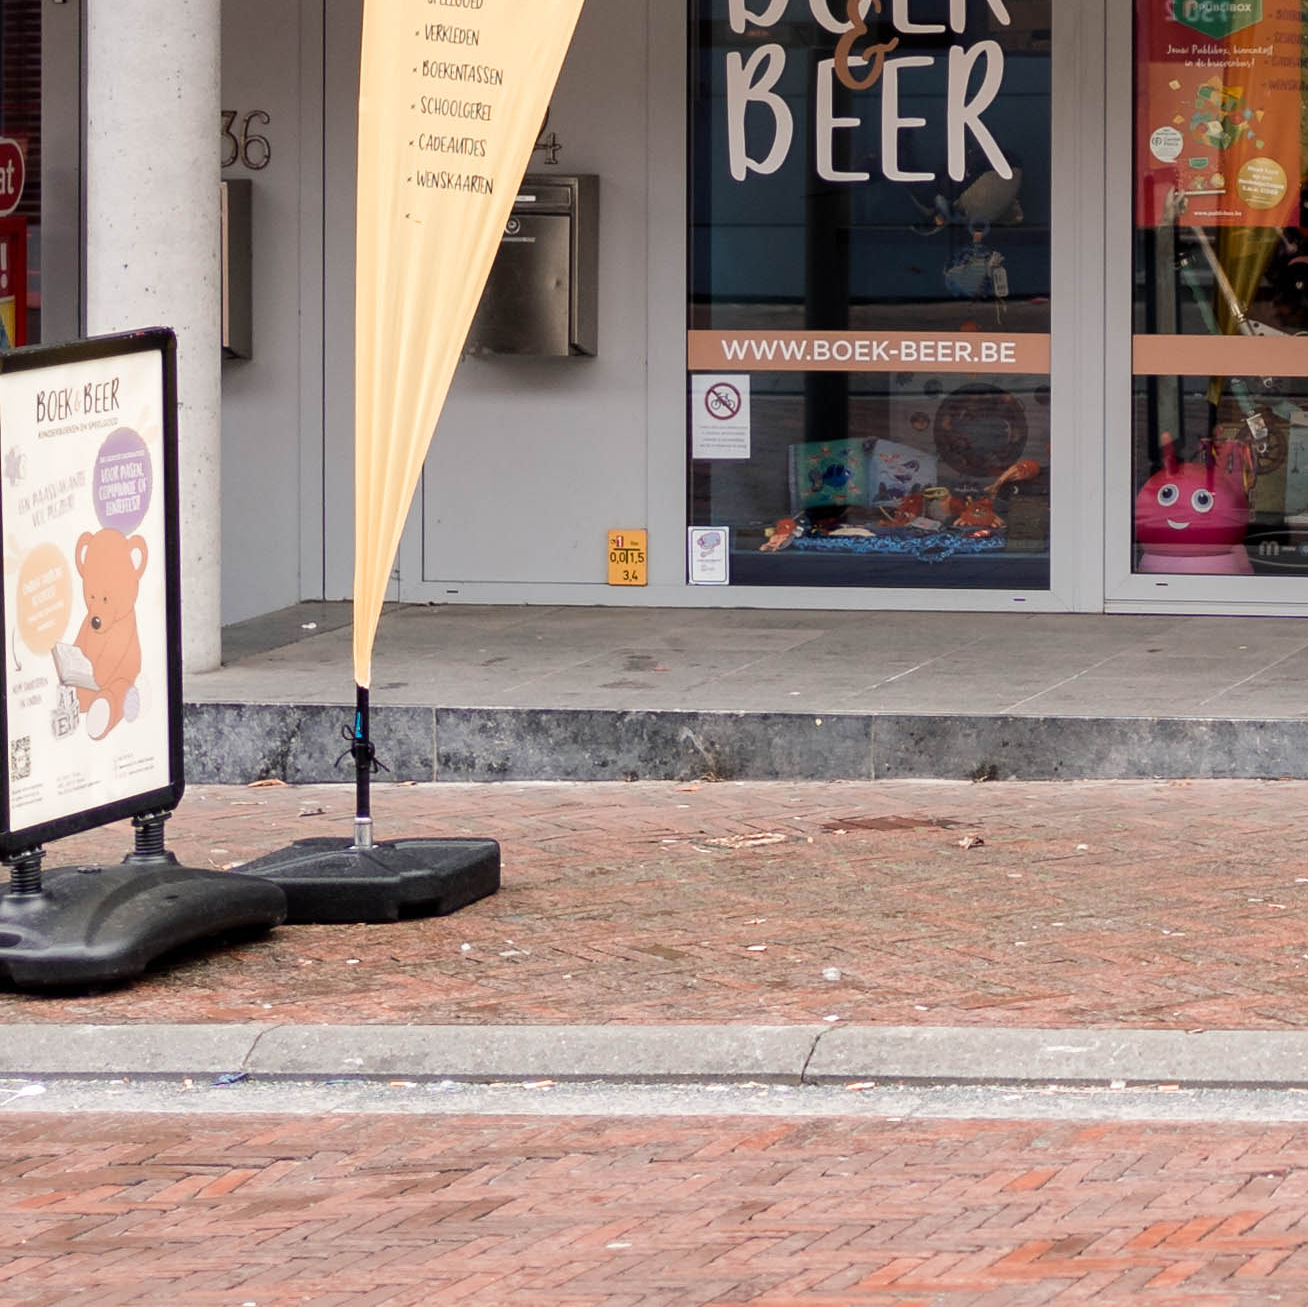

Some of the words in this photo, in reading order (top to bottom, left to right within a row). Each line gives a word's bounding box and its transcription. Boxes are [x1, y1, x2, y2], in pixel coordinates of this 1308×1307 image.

[425, 24, 480, 46] VERKLEDEN
[422, 60, 504, 86] BOEKENTASSEN
[420, 96, 493, 122] SCHOOLGEREI
[725, 38, 1014, 183] BEER
[416, 170, 495, 195] WENSKAARTEN
[721, 339, 1017, 363] WWW.BOEK-BEER.BE
[37, 388, 72, 423] BOEK
[84, 377, 120, 415] BEER
